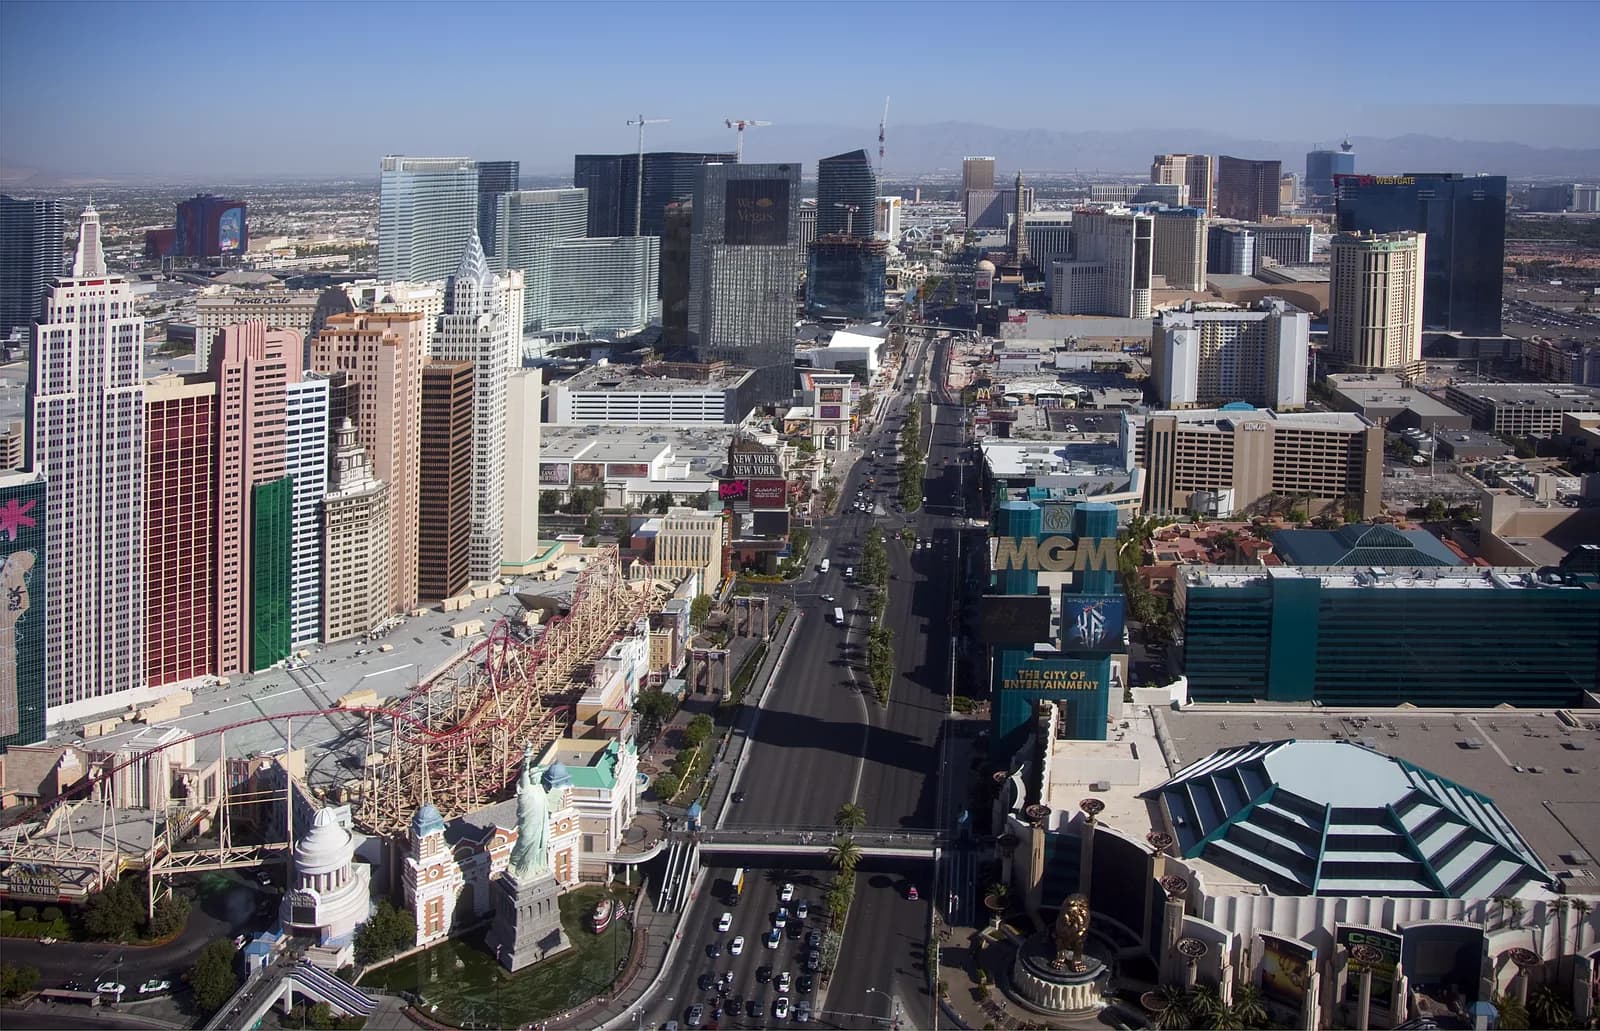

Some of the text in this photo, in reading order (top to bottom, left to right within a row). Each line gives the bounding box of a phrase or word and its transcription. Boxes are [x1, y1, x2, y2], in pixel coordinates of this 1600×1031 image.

[1375, 175, 1415, 184] WESTGATE
[733, 454, 775, 464] NEW YORK
[733, 465, 775, 475] NEW YORK
[719, 480, 746, 498] ROK
[996, 536, 1118, 571] MGM
[1018, 670, 1086, 680] THE CITY OF
[1003, 680, 1099, 690] ENTERTAINMENT
[11, 876, 30, 884] NEW
[31, 886, 57, 895] YORK
